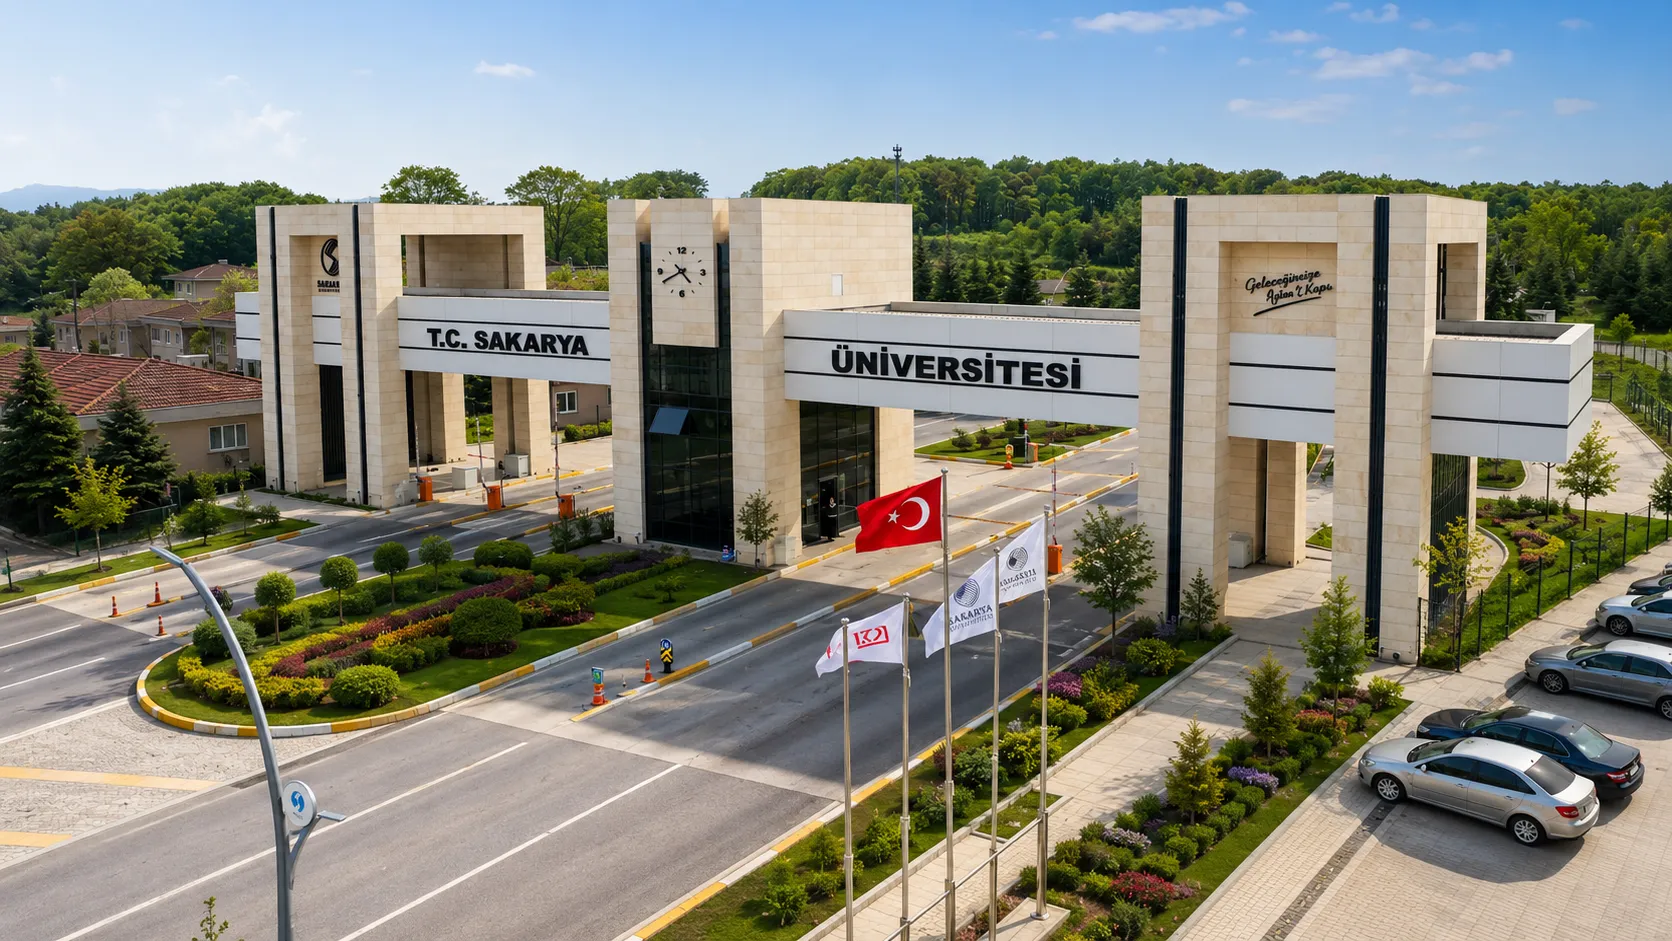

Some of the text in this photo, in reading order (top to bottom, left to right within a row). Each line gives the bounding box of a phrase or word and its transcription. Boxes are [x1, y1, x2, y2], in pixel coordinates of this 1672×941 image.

[677, 246, 687, 254] 12
[657, 267, 664, 275] 9
[679, 289, 685, 298] 6
[427, 328, 589, 356] T.C. SAKARYA
[831, 344, 1081, 389] ÜNİVERSİTESİ
